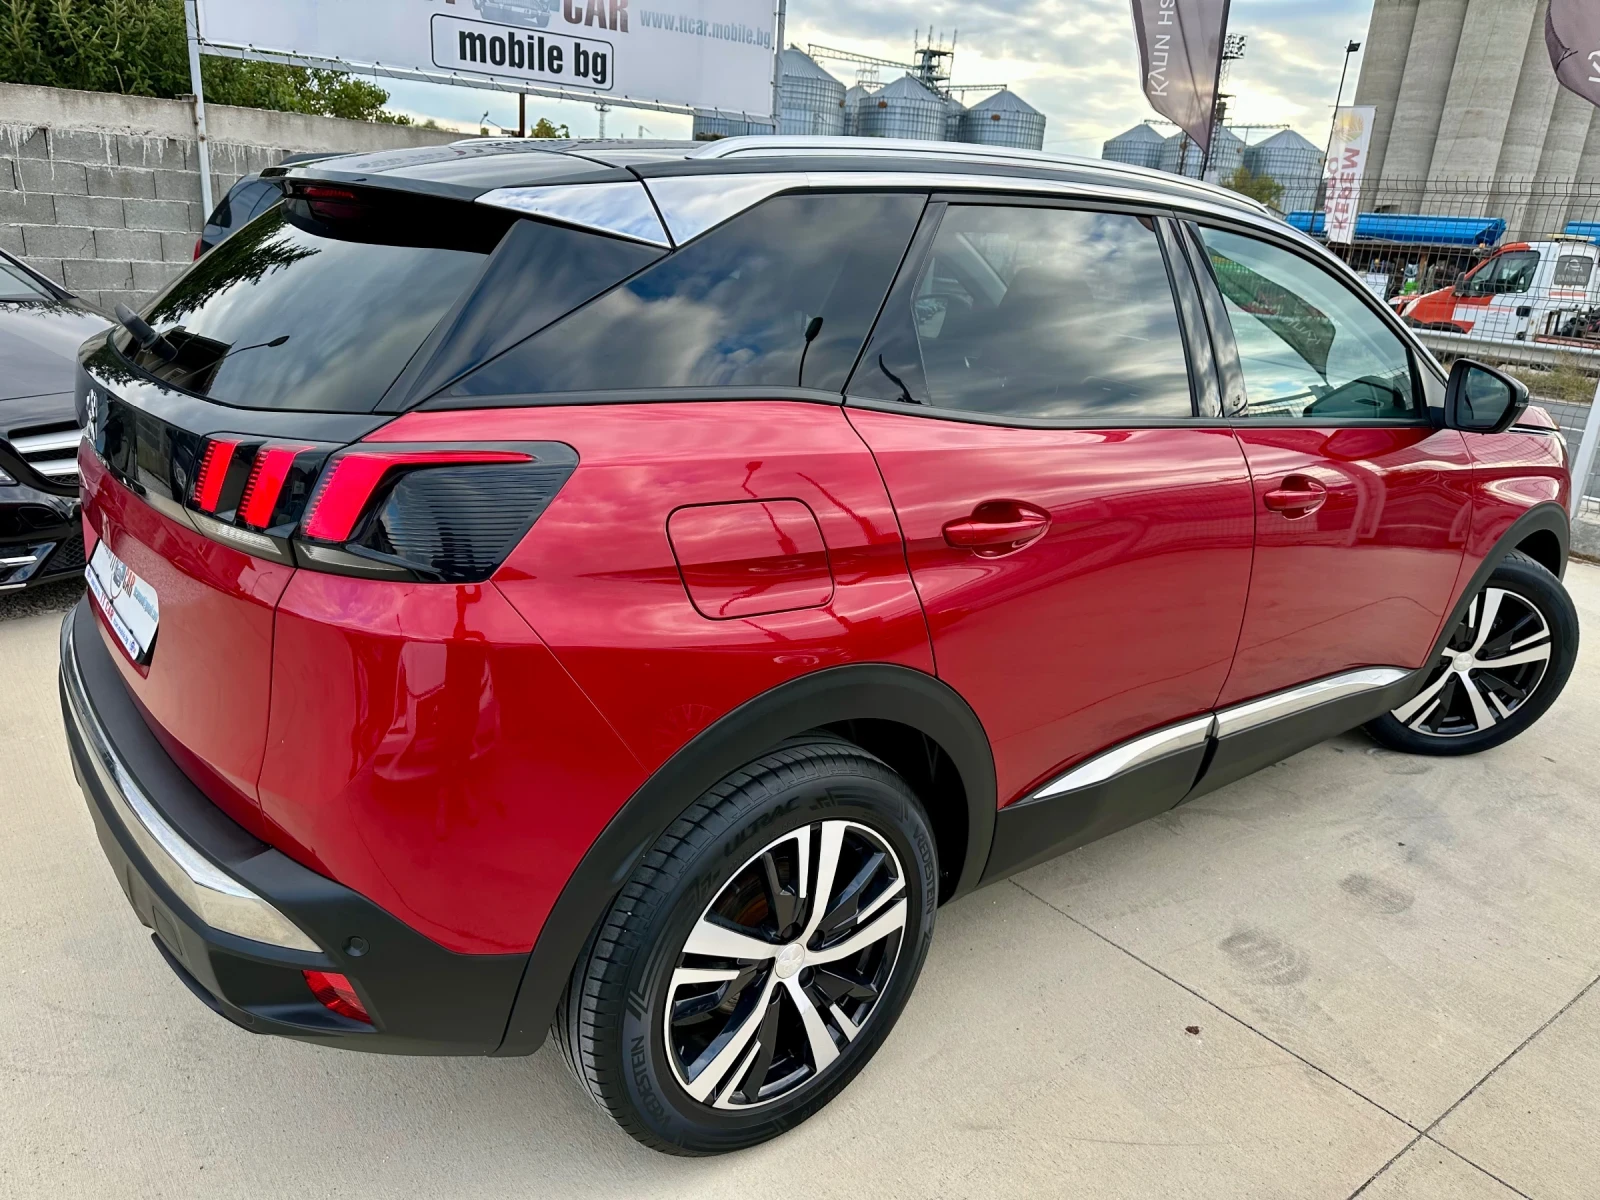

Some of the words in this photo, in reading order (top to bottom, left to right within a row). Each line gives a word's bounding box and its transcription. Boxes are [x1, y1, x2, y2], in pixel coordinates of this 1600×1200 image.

[563, 0, 629, 33] CAR
[640, 9, 772, 49] www.ttcar.mobile.bg
[459, 30, 563, 75] mobile
[574, 42, 607, 84] bg
[912, 823, 935, 915] VREDESTEIN
[630, 1035, 672, 1129] VREDESTEIN
